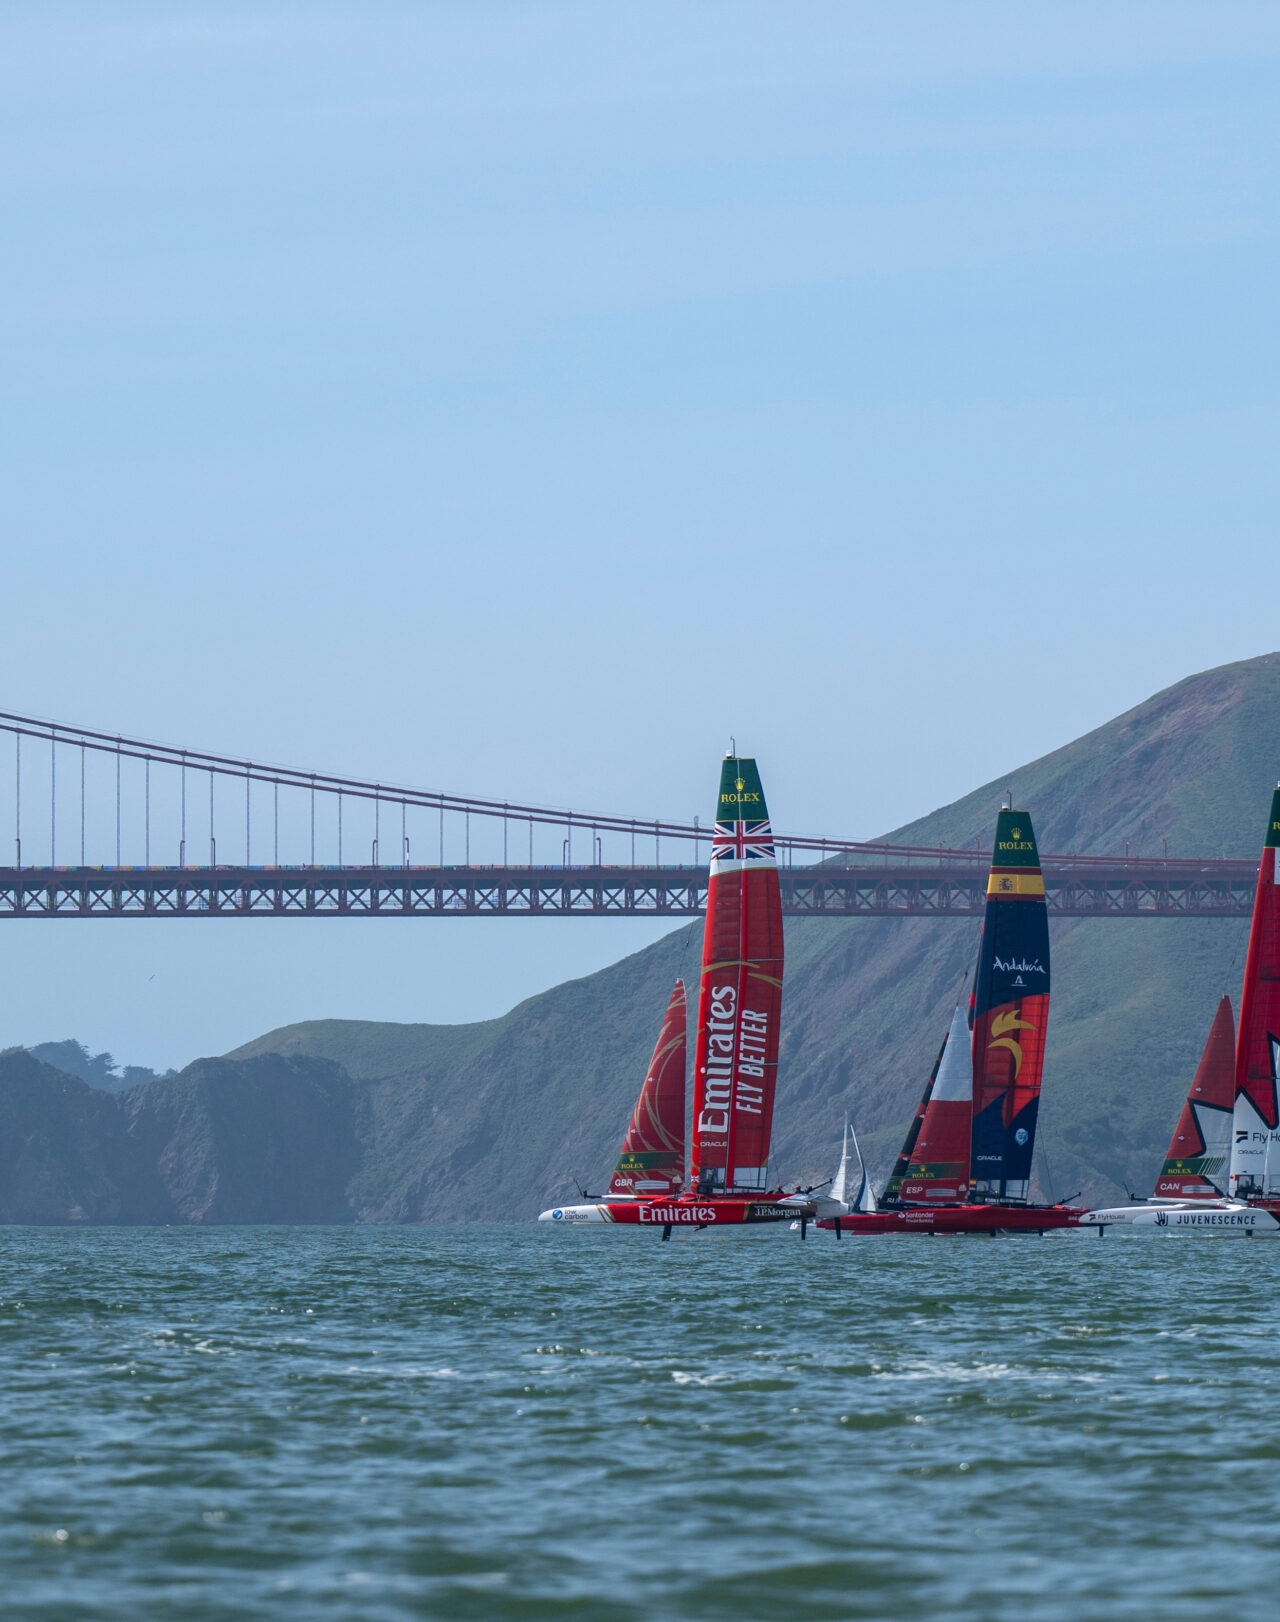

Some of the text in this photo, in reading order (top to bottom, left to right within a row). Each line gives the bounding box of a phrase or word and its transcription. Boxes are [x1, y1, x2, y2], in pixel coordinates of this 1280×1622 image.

[720, 793, 760, 803] ROLEX
[999, 841, 1034, 850] ROLEX
[698, 985, 737, 1133] Emirates
[735, 1009, 768, 1115] FLY BETTER
[614, 1179, 633, 1187] GBR
[1160, 1183, 1180, 1191] CAN
[906, 1186, 923, 1194] ESP
[638, 1205, 717, 1222] Emirates
[1177, 1215, 1256, 1225] JUVENESCENCE
